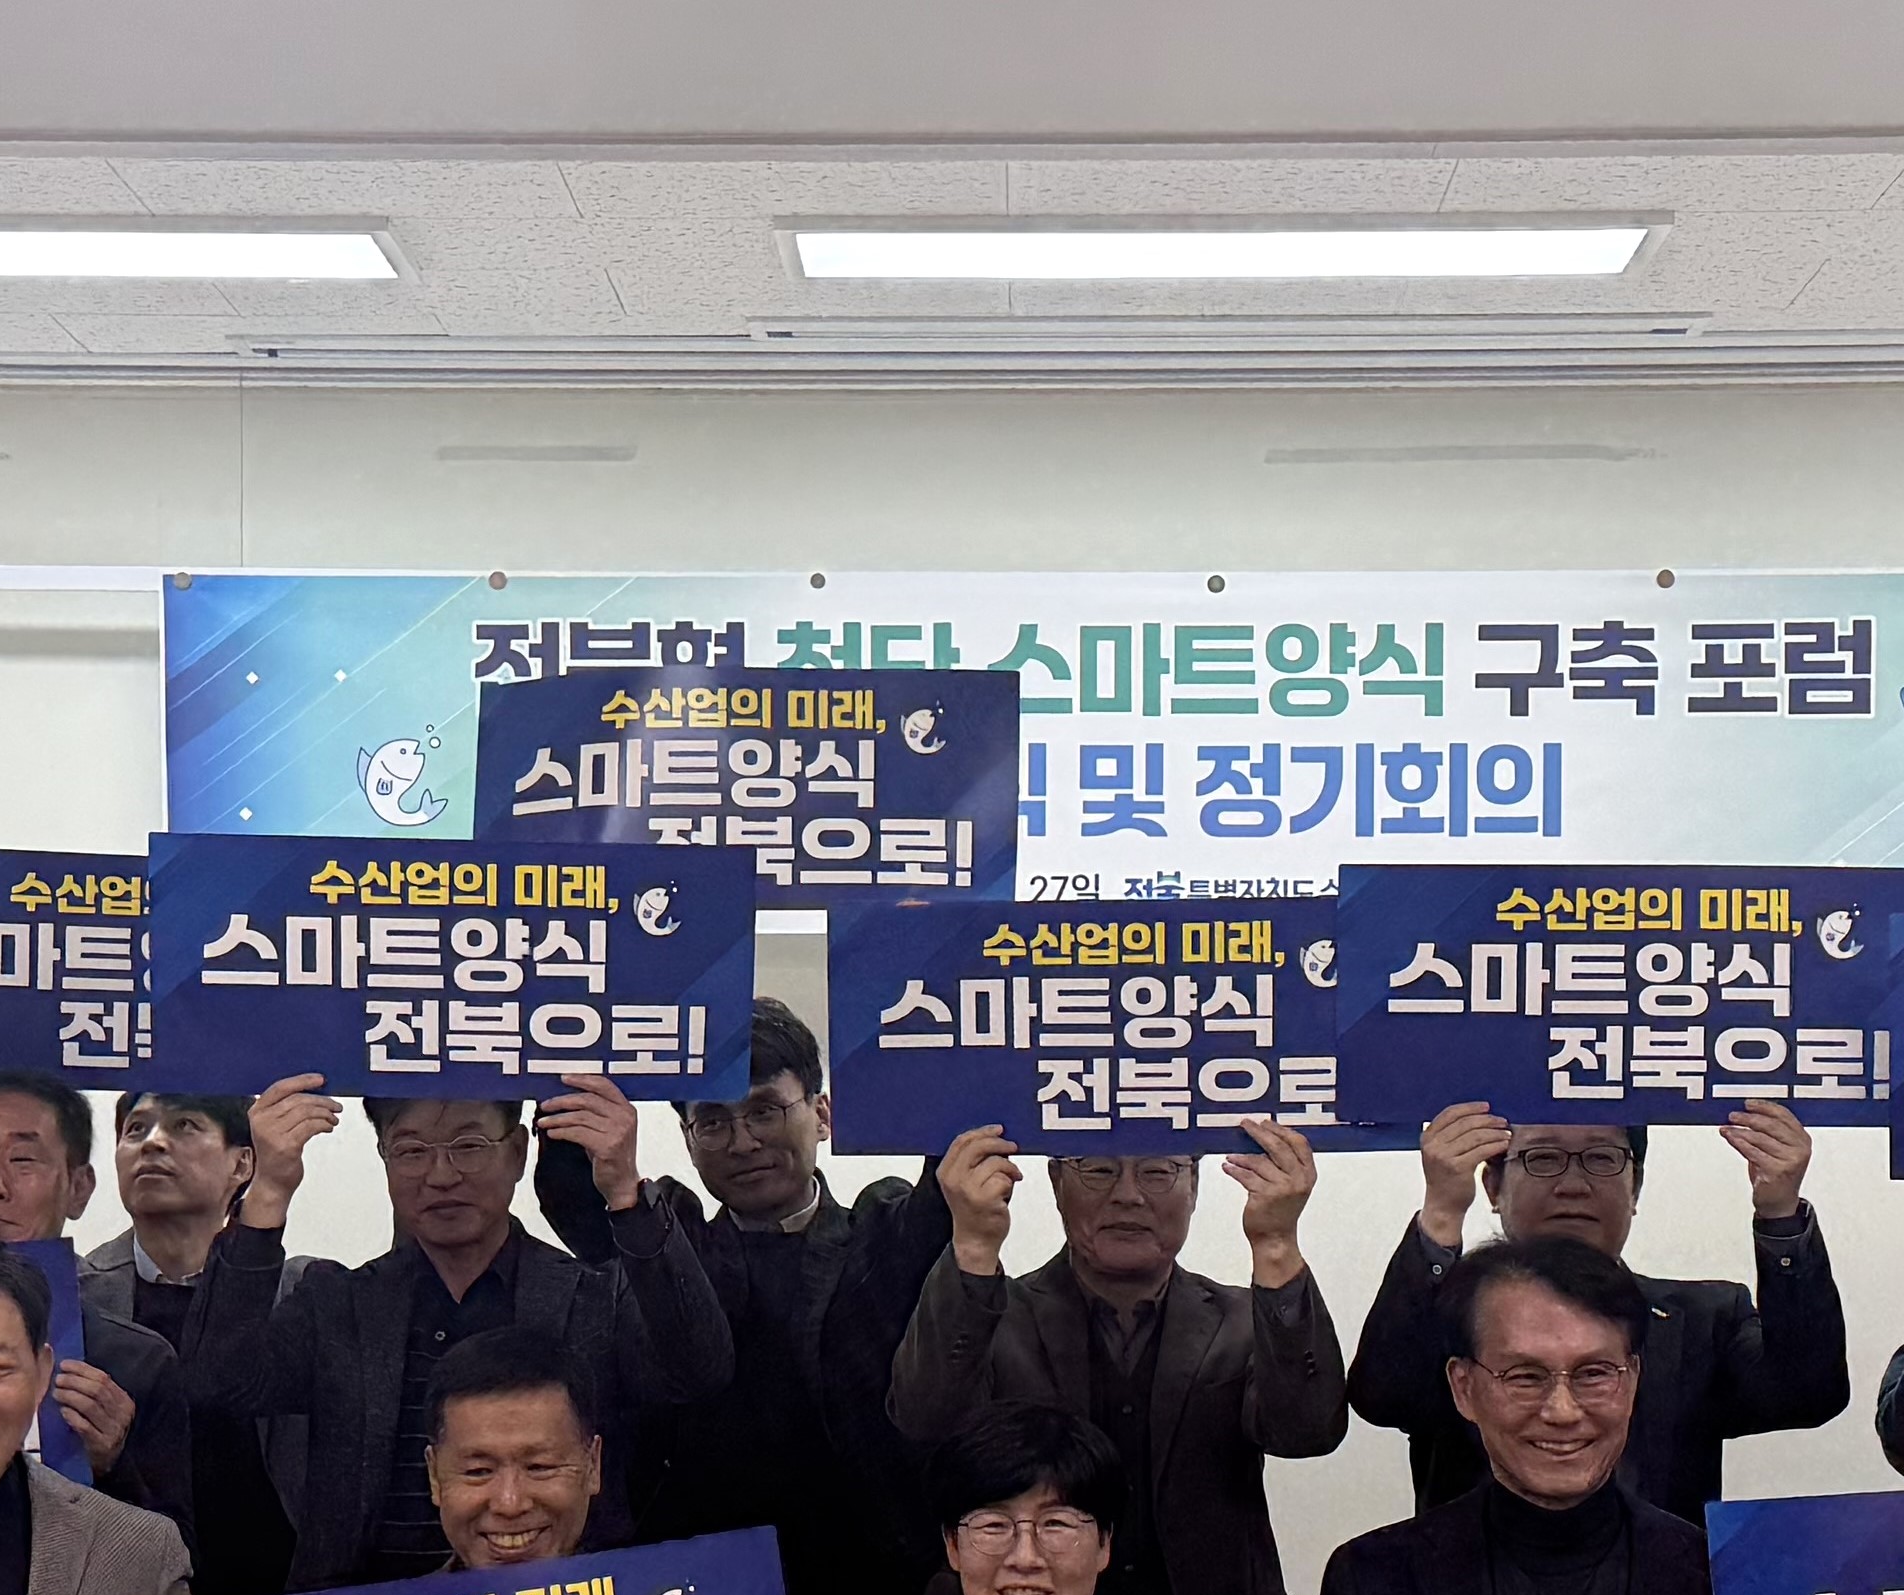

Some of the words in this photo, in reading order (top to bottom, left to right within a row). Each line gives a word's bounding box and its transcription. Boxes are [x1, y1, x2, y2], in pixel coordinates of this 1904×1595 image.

[986, 620, 1446, 718] 스마트양식
[1474, 620, 1660, 716] 구축
[1686, 619, 1874, 718] 포럼
[601, 687, 771, 729] 수산업의
[787, 689, 886, 733] 미래,
[512, 738, 875, 815] 스마트양식
[1080, 744, 1165, 838] 및
[1194, 742, 1562, 838] 정기회의
[9, 873, 150, 916] 수산업
[309, 861, 498, 908] 수산업의
[512, 864, 620, 916] 미래,
[1496, 887, 1684, 934] 수산업의
[1698, 887, 1803, 938] 미래,
[201, 912, 607, 994] 스마트양식
[982, 921, 1168, 968] 수산업의
[1182, 921, 1286, 969] 미래,
[1387, 941, 1792, 1018] 스마트양식
[365, 1000, 707, 1076] 전북으로!
[877, 976, 1273, 1050] 스마트양식
[1547, 1025, 1891, 1101] 전북으로!
